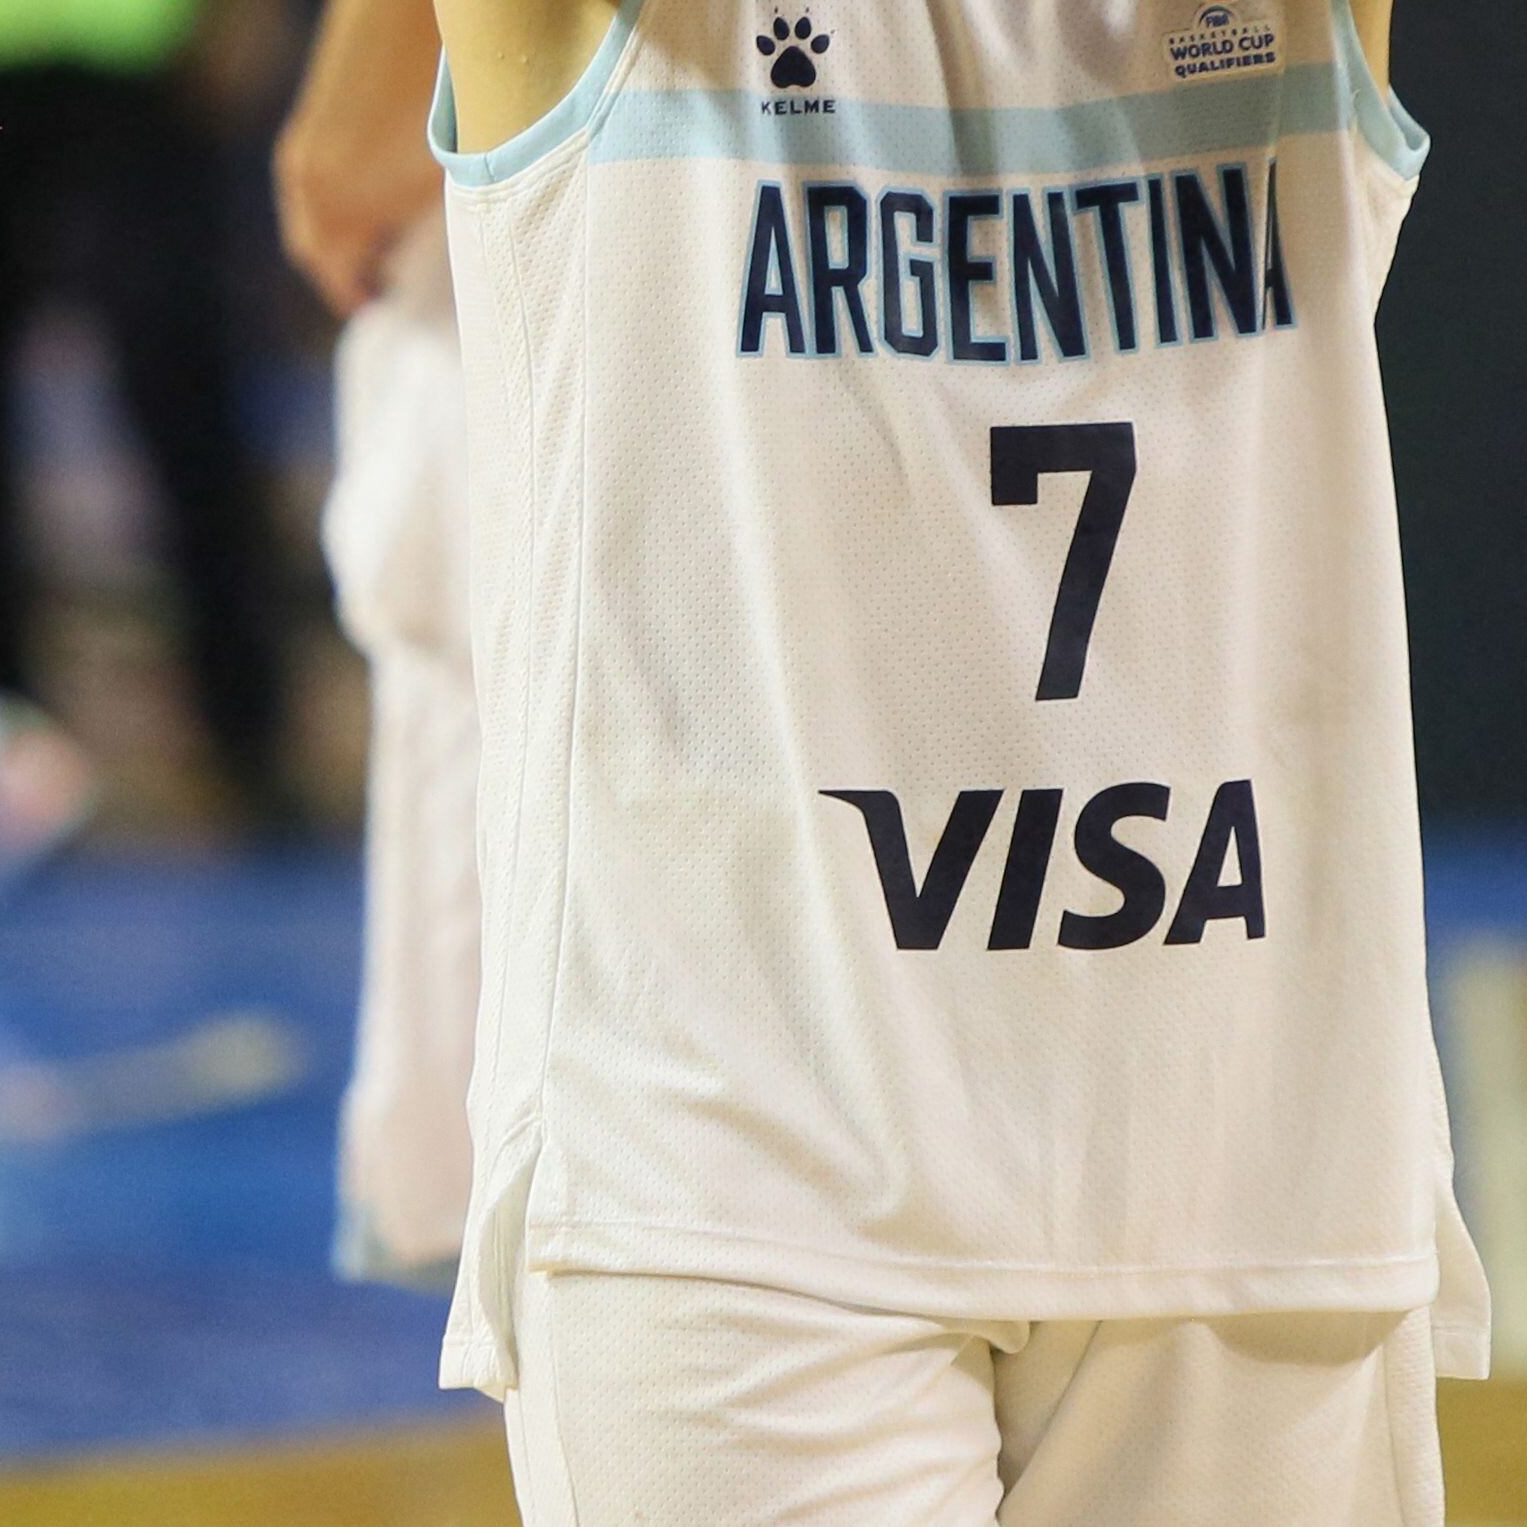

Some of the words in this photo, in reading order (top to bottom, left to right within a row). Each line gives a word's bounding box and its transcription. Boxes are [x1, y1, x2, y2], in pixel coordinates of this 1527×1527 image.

[1170, 39, 1234, 60] WORLD
[1238, 33, 1275, 51] CUP
[1175, 52, 1276, 78] QUALIFIERS
[761, 97, 836, 115] KELME
[735, 157, 1298, 365] ARGENTINA
[989, 421, 1138, 702] 7
[818, 779, 1267, 950] VISA
